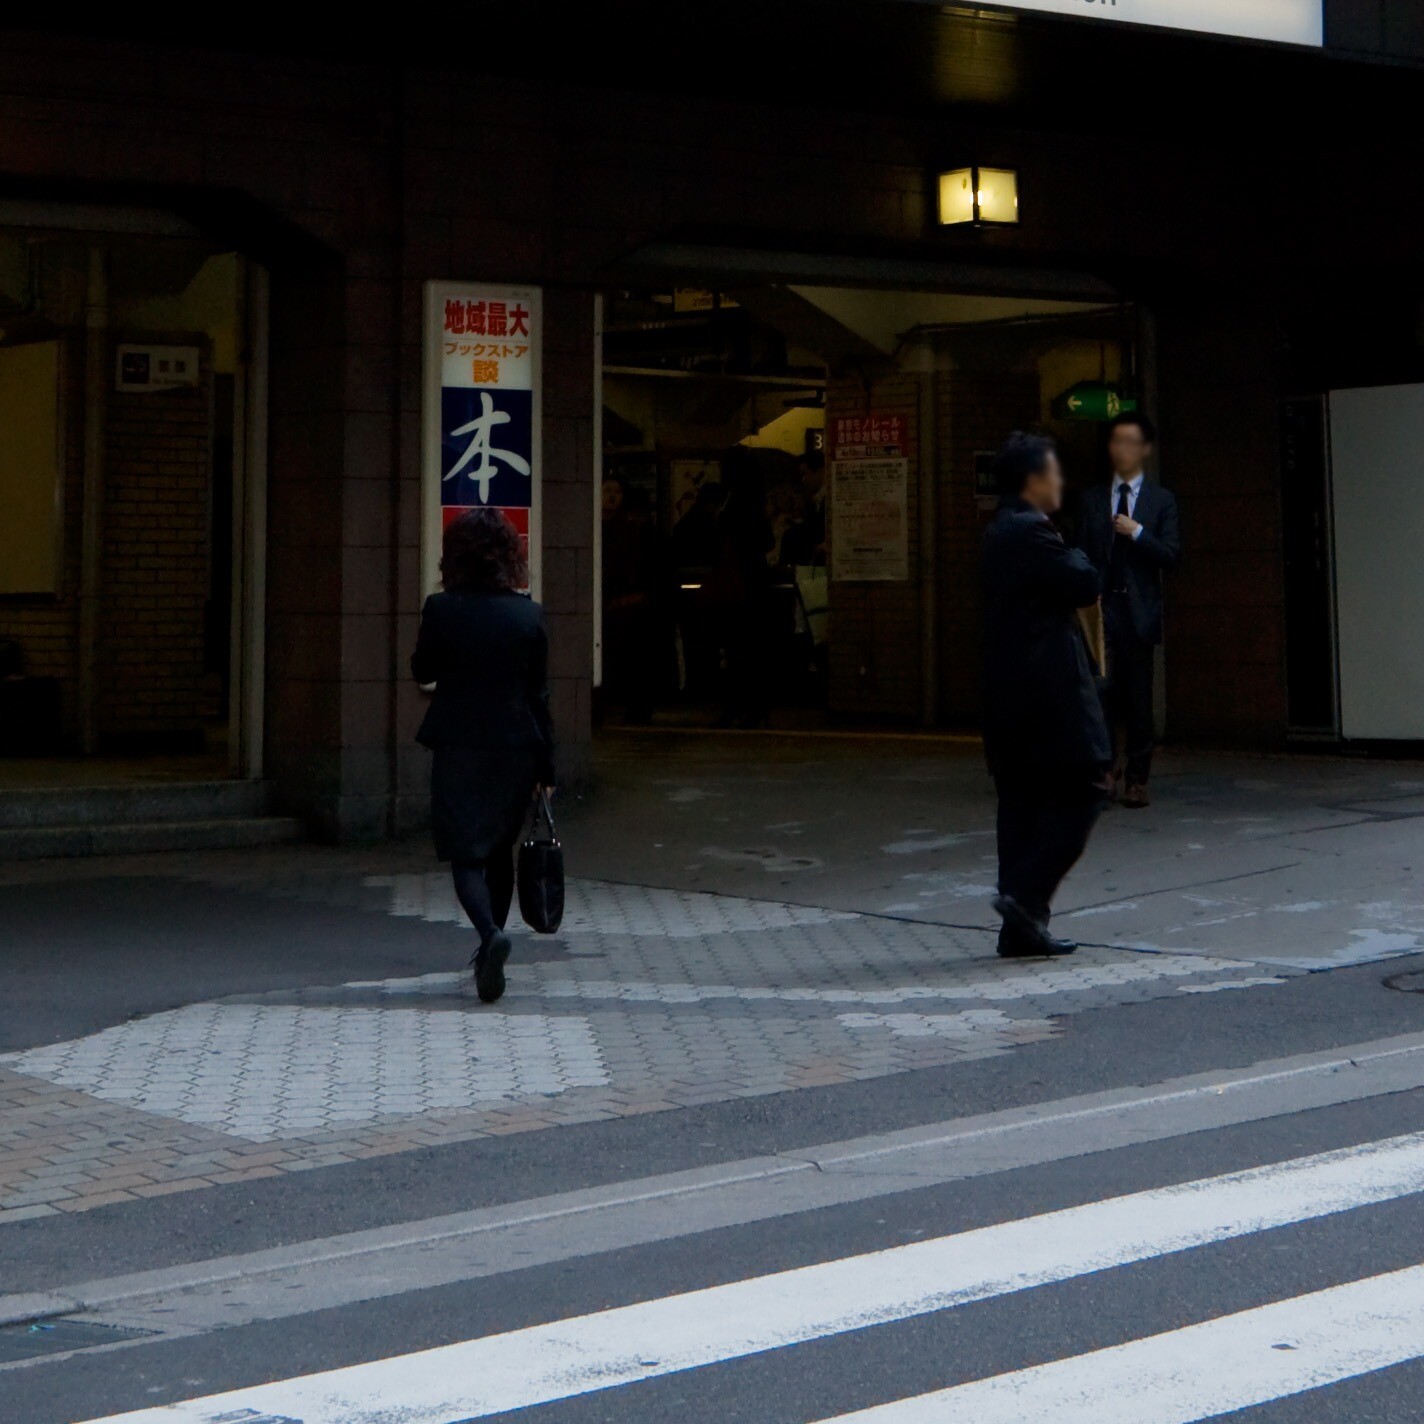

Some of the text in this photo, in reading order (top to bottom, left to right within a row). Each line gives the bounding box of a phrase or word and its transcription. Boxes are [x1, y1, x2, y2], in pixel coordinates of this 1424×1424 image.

[444, 299, 530, 338] 地域最大
[445, 342, 529, 358] ブックストア
[473, 359, 499, 384] 談
[442, 391, 532, 504] 本
